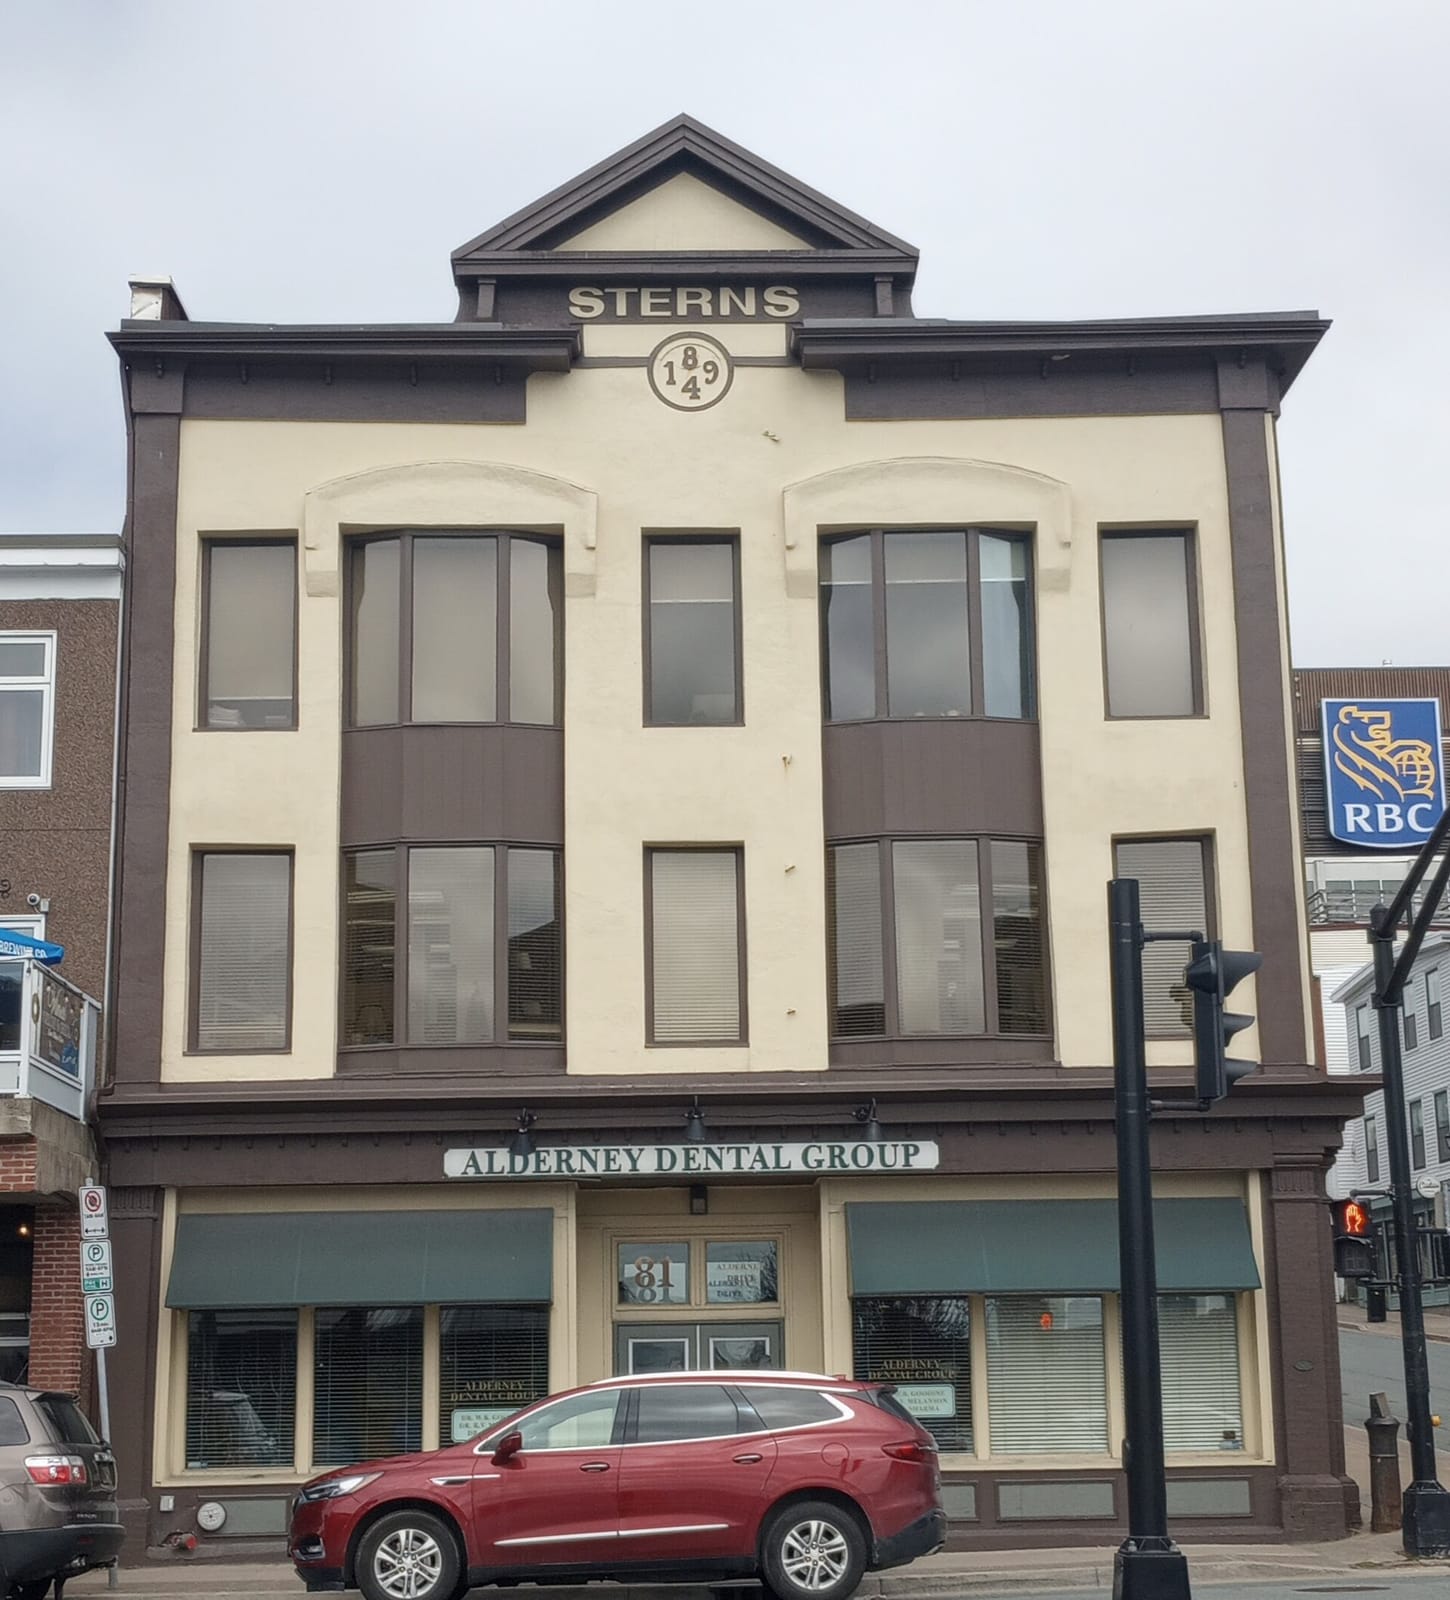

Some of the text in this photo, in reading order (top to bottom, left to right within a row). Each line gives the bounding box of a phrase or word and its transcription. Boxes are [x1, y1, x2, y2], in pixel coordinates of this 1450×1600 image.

[568, 286, 800, 319] STERNS
[1343, 803, 1436, 833] RBC
[461, 1143, 920, 1175] ALDERNEY DENTAL GROUP
[634, 1256, 675, 1288] 81
[880, 1359, 942, 1370] ALDERNEY
[868, 1370, 912, 1380] DENTAL
[463, 1380, 524, 1391] ALDERNEY
[450, 1391, 539, 1402] DENTAL GROUP
